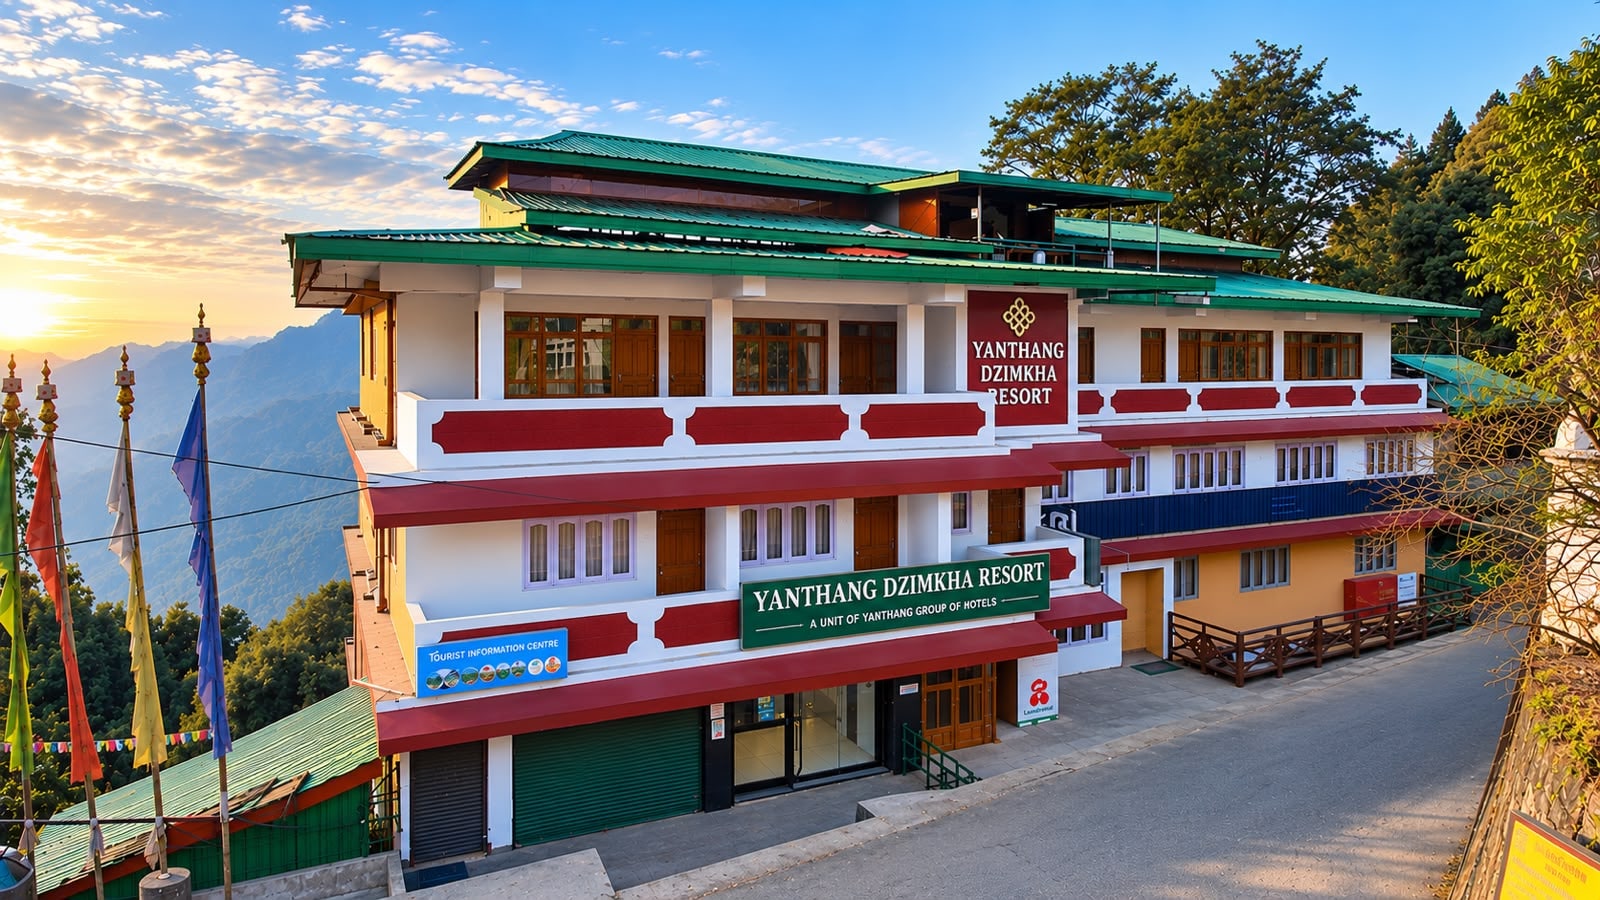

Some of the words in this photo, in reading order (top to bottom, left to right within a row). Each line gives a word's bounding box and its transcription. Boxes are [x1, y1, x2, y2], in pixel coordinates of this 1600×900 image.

[972, 341, 1065, 359] YANTHANG
[980, 365, 1057, 382] DZIMKHA
[753, 579, 878, 612] YANTHANG
[883, 569, 974, 598] DZIMKHA
[978, 561, 1045, 587] RESORT
[809, 619, 817, 629] A
[820, 615, 844, 628] UNIT
[846, 613, 860, 625] OF
[862, 607, 913, 622] YANTHANG
[915, 603, 947, 617] GROUP
[949, 601, 961, 612] OF
[964, 597, 997, 610] HOTELS
[428, 650, 466, 663] TOURIST
[467, 643, 525, 658] INFORMATION
[526, 639, 559, 651] CENTRE
